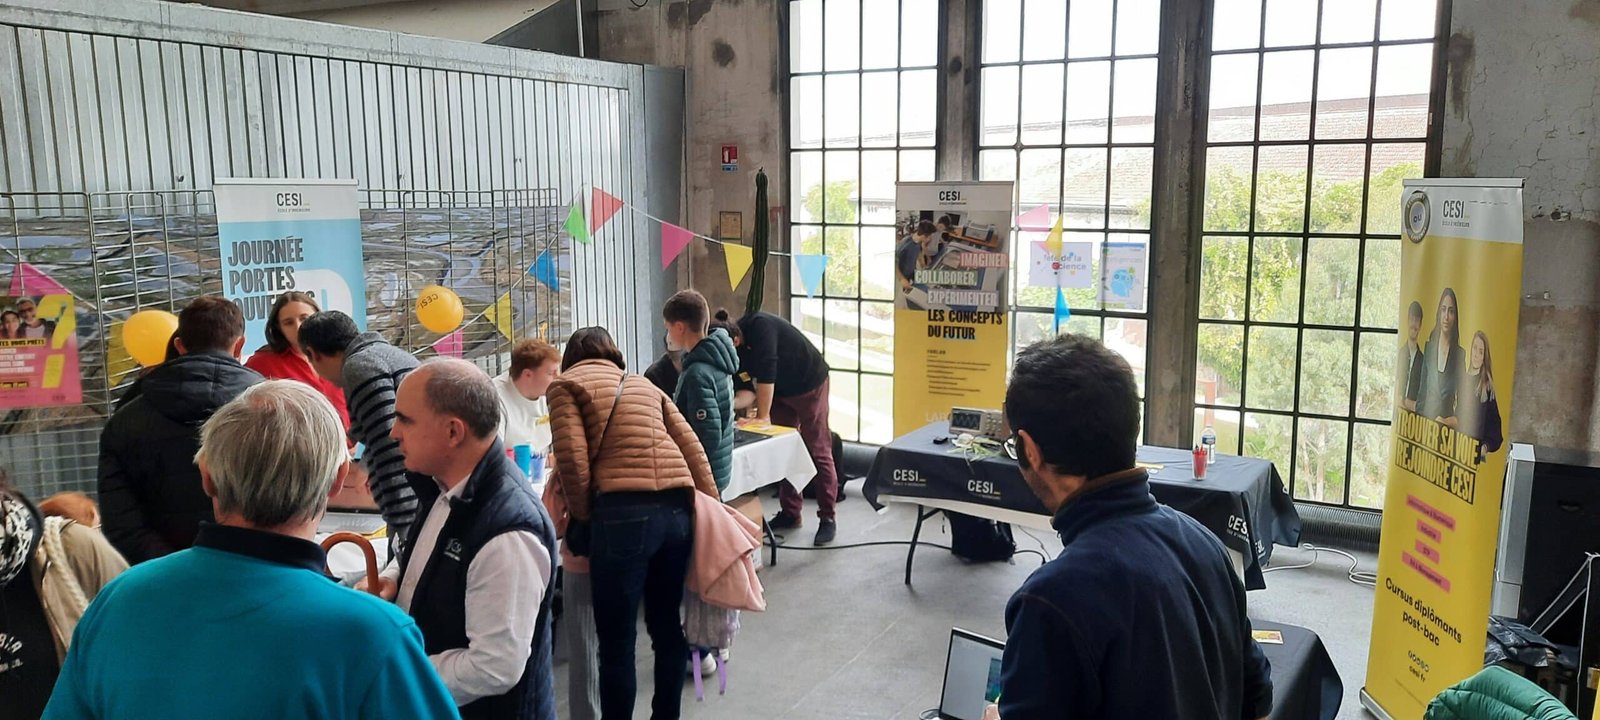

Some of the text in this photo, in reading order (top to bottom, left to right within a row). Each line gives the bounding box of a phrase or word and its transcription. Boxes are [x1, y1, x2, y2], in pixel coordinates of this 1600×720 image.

[276, 192, 303, 206] CESI
[938, 190, 961, 201] CESI
[1442, 200, 1465, 219] CESI
[227, 235, 304, 267] JOURNÉE
[228, 266, 296, 296] PORTES
[417, 293, 439, 309] CESI
[927, 308, 1003, 325] LES CONCEPTS
[927, 325, 976, 340] DU FUTUR
[1398, 408, 1440, 451] TROUVER
[1440, 425, 1455, 458] SA
[893, 469, 919, 482] CESI
[1396, 440, 1475, 503] REJOINDRE CESI
[967, 479, 994, 494] CESI
[1228, 514, 1249, 537] CES
[1385, 577, 1462, 644] Cursus diplômants
[1402, 611, 1440, 646] post-bac
